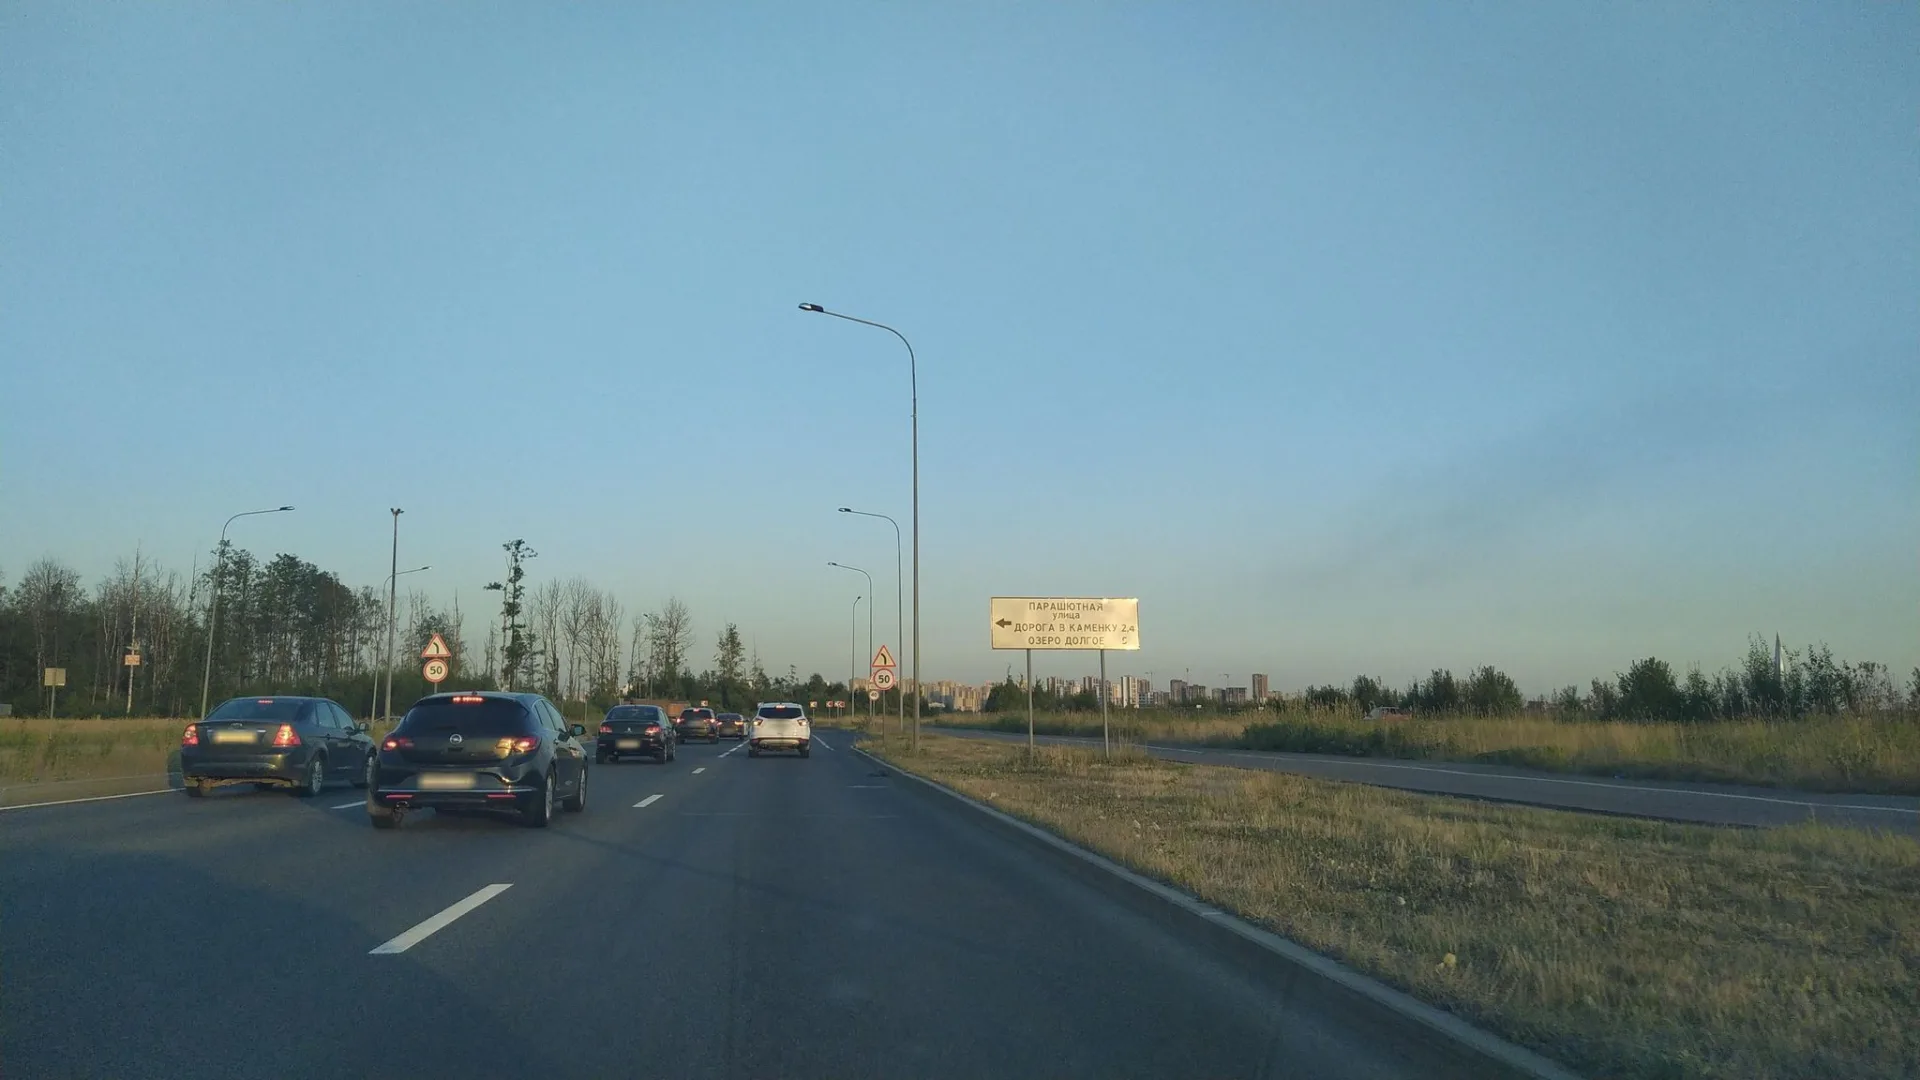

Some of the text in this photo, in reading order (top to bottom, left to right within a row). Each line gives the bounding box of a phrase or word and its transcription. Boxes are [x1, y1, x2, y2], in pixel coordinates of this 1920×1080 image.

[1028, 602, 1104, 611] ПАРАШЮТНАЯ
[1052, 611, 1080, 620] улица
[1014, 623, 1055, 633] ДОРОГА
[1059, 624, 1066, 632] В
[1069, 623, 1118, 632] КАМЕНКУ
[1028, 636, 1061, 645] ОЗЕРО
[1065, 636, 1105, 646] ДОЛГОЕ
[430, 666, 442, 675] 50
[878, 675, 890, 683] 50
